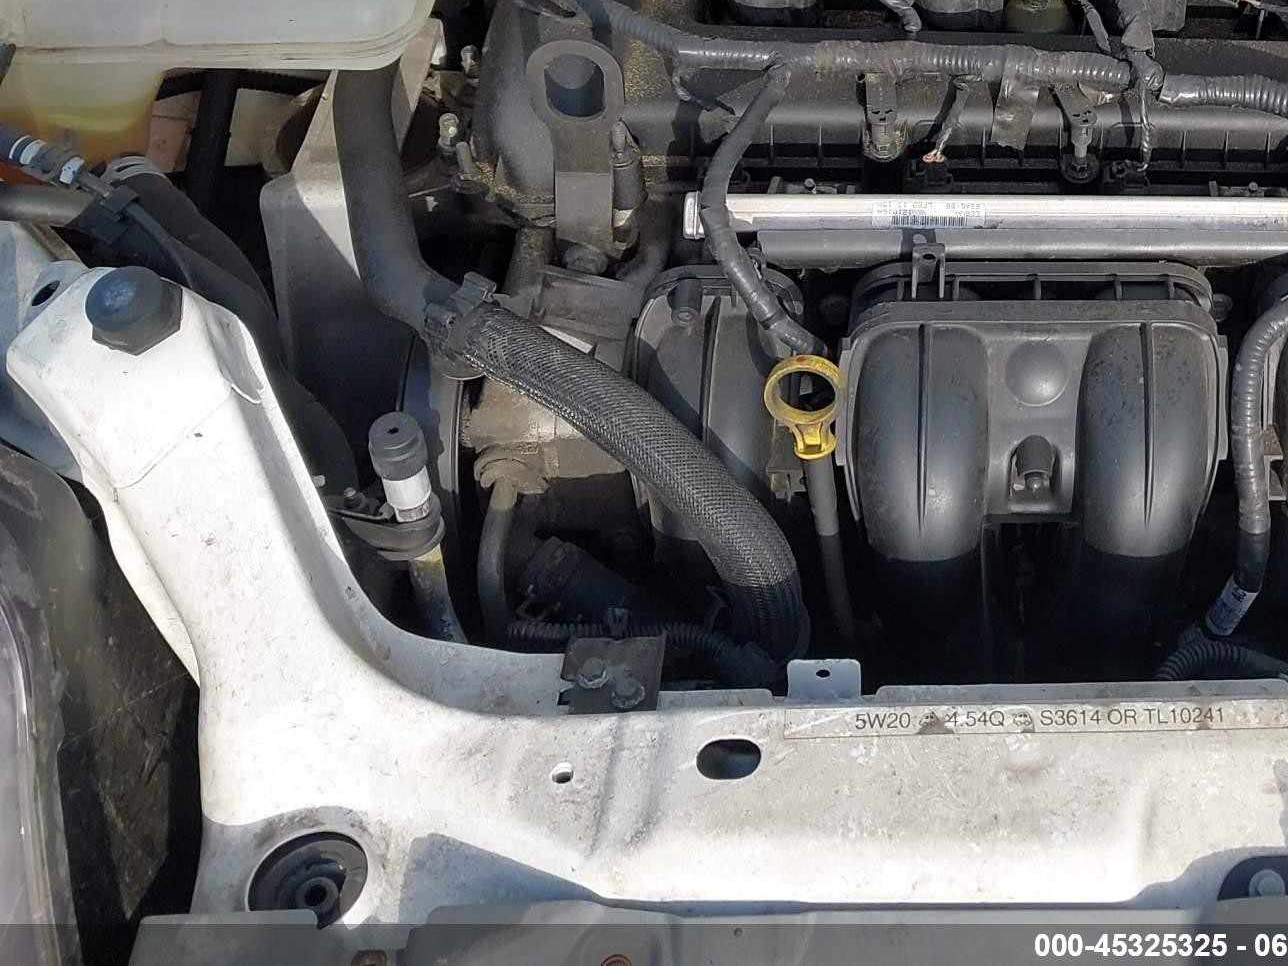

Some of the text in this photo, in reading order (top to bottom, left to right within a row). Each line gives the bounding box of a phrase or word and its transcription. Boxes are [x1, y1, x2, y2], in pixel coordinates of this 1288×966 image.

[855, 707, 1224, 730] 5W20 4.54Q S3614 OR TL10241
